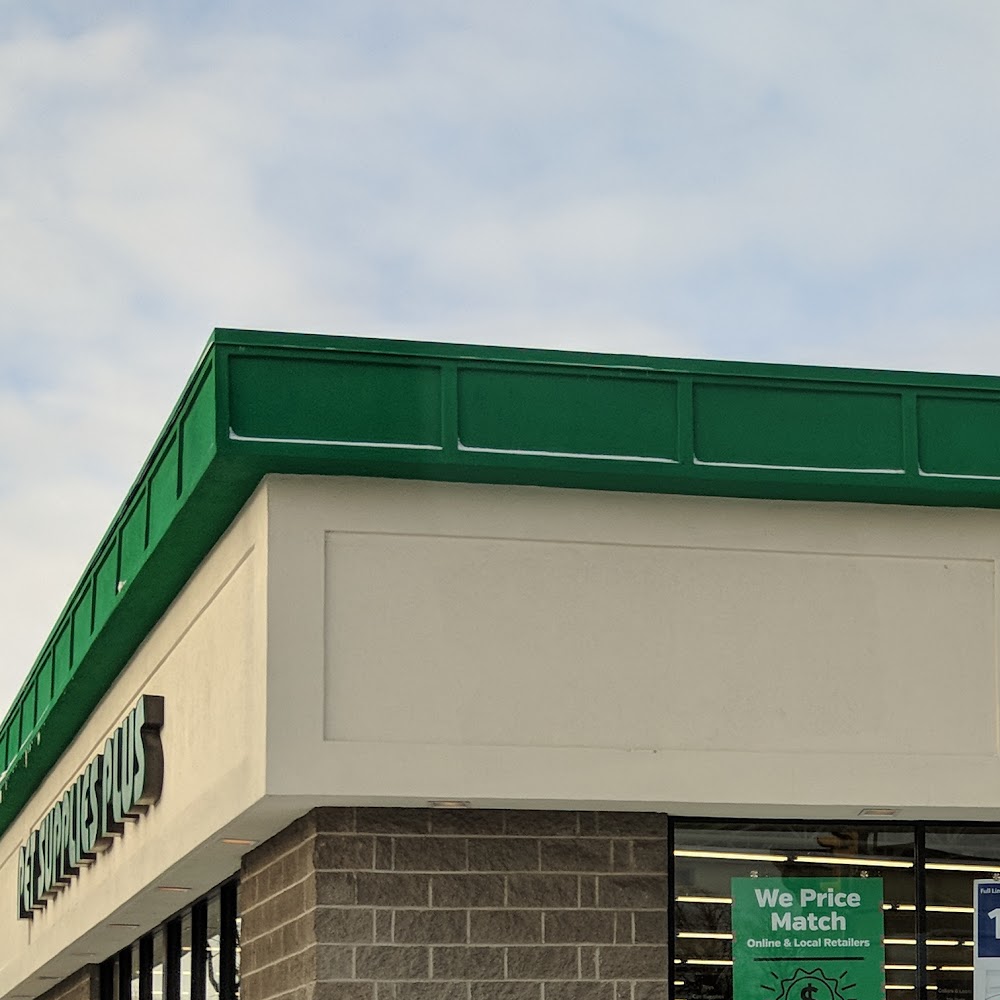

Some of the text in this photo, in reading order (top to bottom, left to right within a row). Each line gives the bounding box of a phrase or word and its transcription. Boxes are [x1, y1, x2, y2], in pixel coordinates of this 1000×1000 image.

[101, 694, 163, 838] PLUS
[754, 887, 861, 908] We Price
[980, 887, 991, 895] Full
[771, 911, 847, 932] Match
[747, 938, 870, 948] Online & Local Retailers
